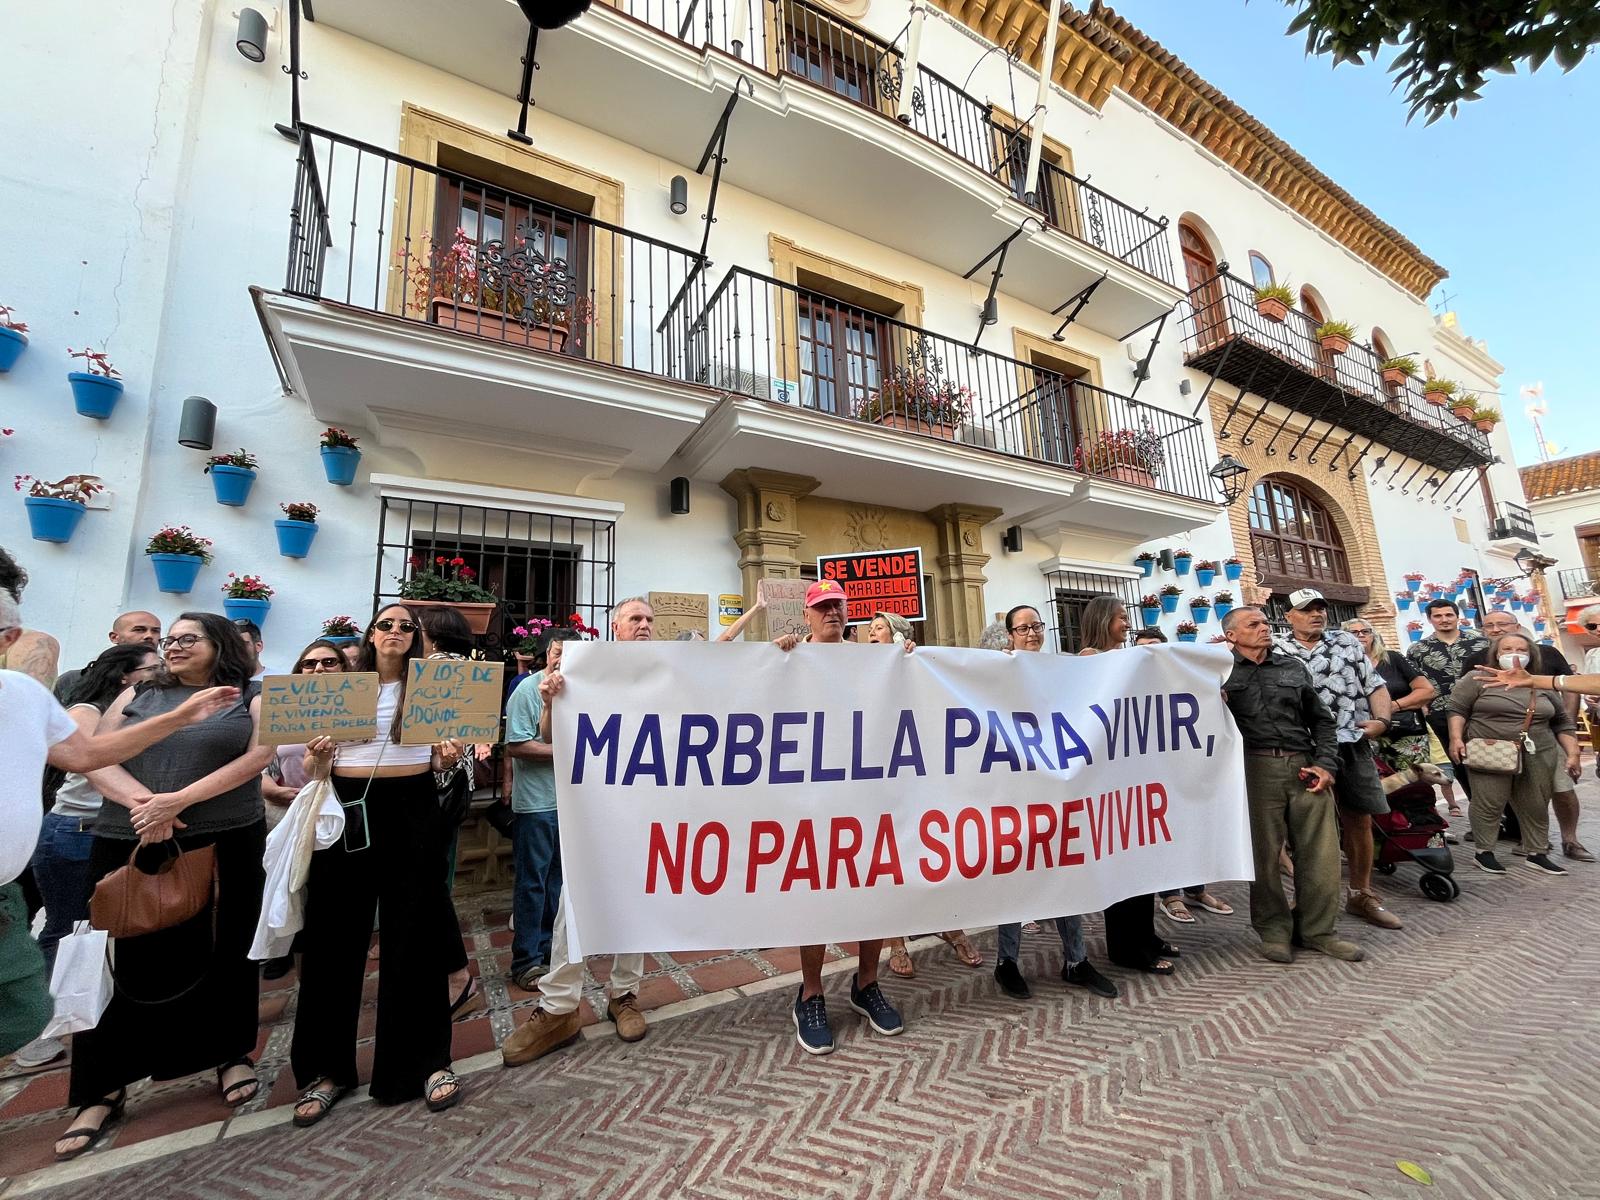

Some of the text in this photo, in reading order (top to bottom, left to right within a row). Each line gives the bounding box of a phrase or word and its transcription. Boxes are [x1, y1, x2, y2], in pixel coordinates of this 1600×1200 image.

[824, 554, 917, 581] SE VENDE
[848, 578, 917, 597] MARBELLA
[847, 598, 918, 617] SAN PEDRO
[415, 661, 496, 682] Y LOS DE
[290, 678, 369, 695] VILLAS
[269, 694, 345, 706] DE LUJO
[285, 708, 352, 719] VIVIENDA
[270, 723, 305, 732] PARA
[311, 721, 329, 730] EL
[570, 692, 1215, 787] MARBELLA PARA VIVIR,
[645, 782, 1172, 896] NO PARA SOBREVIVIR
